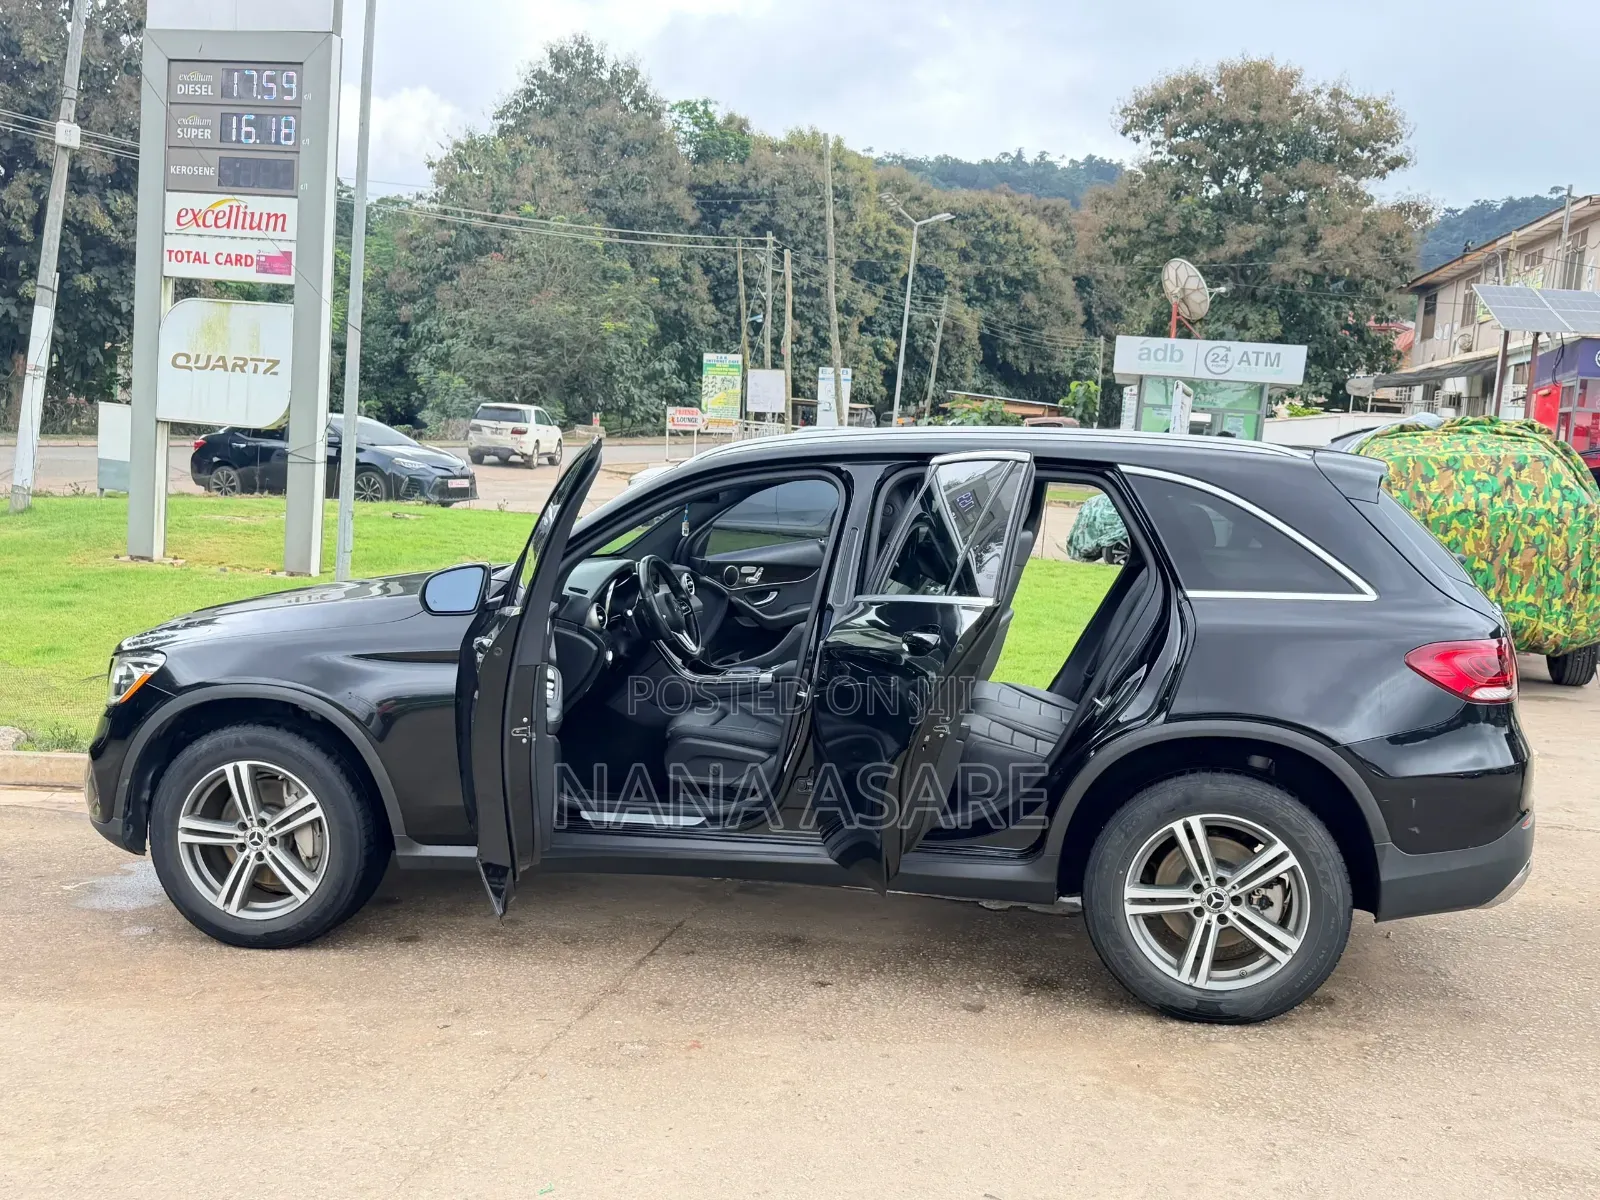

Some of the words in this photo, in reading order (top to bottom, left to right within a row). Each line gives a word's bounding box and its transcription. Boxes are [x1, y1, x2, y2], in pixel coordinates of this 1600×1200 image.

[179, 71, 213, 82] excellium
[233, 69, 297, 100] 17.59
[177, 83, 214, 96] DIESEL
[177, 115, 212, 126] excellium
[176, 128, 212, 140] SUPER
[231, 114, 296, 146] 16.18
[170, 165, 216, 176] KEROSENE
[176, 203, 287, 233] excellium
[166, 249, 211, 265] TOTAL
[214, 252, 255, 268] CARD
[1137, 342, 1184, 363] adb
[1210, 352, 1229, 363] 24
[1237, 350, 1281, 368] ATM
[171, 352, 281, 376] QUARTZ
